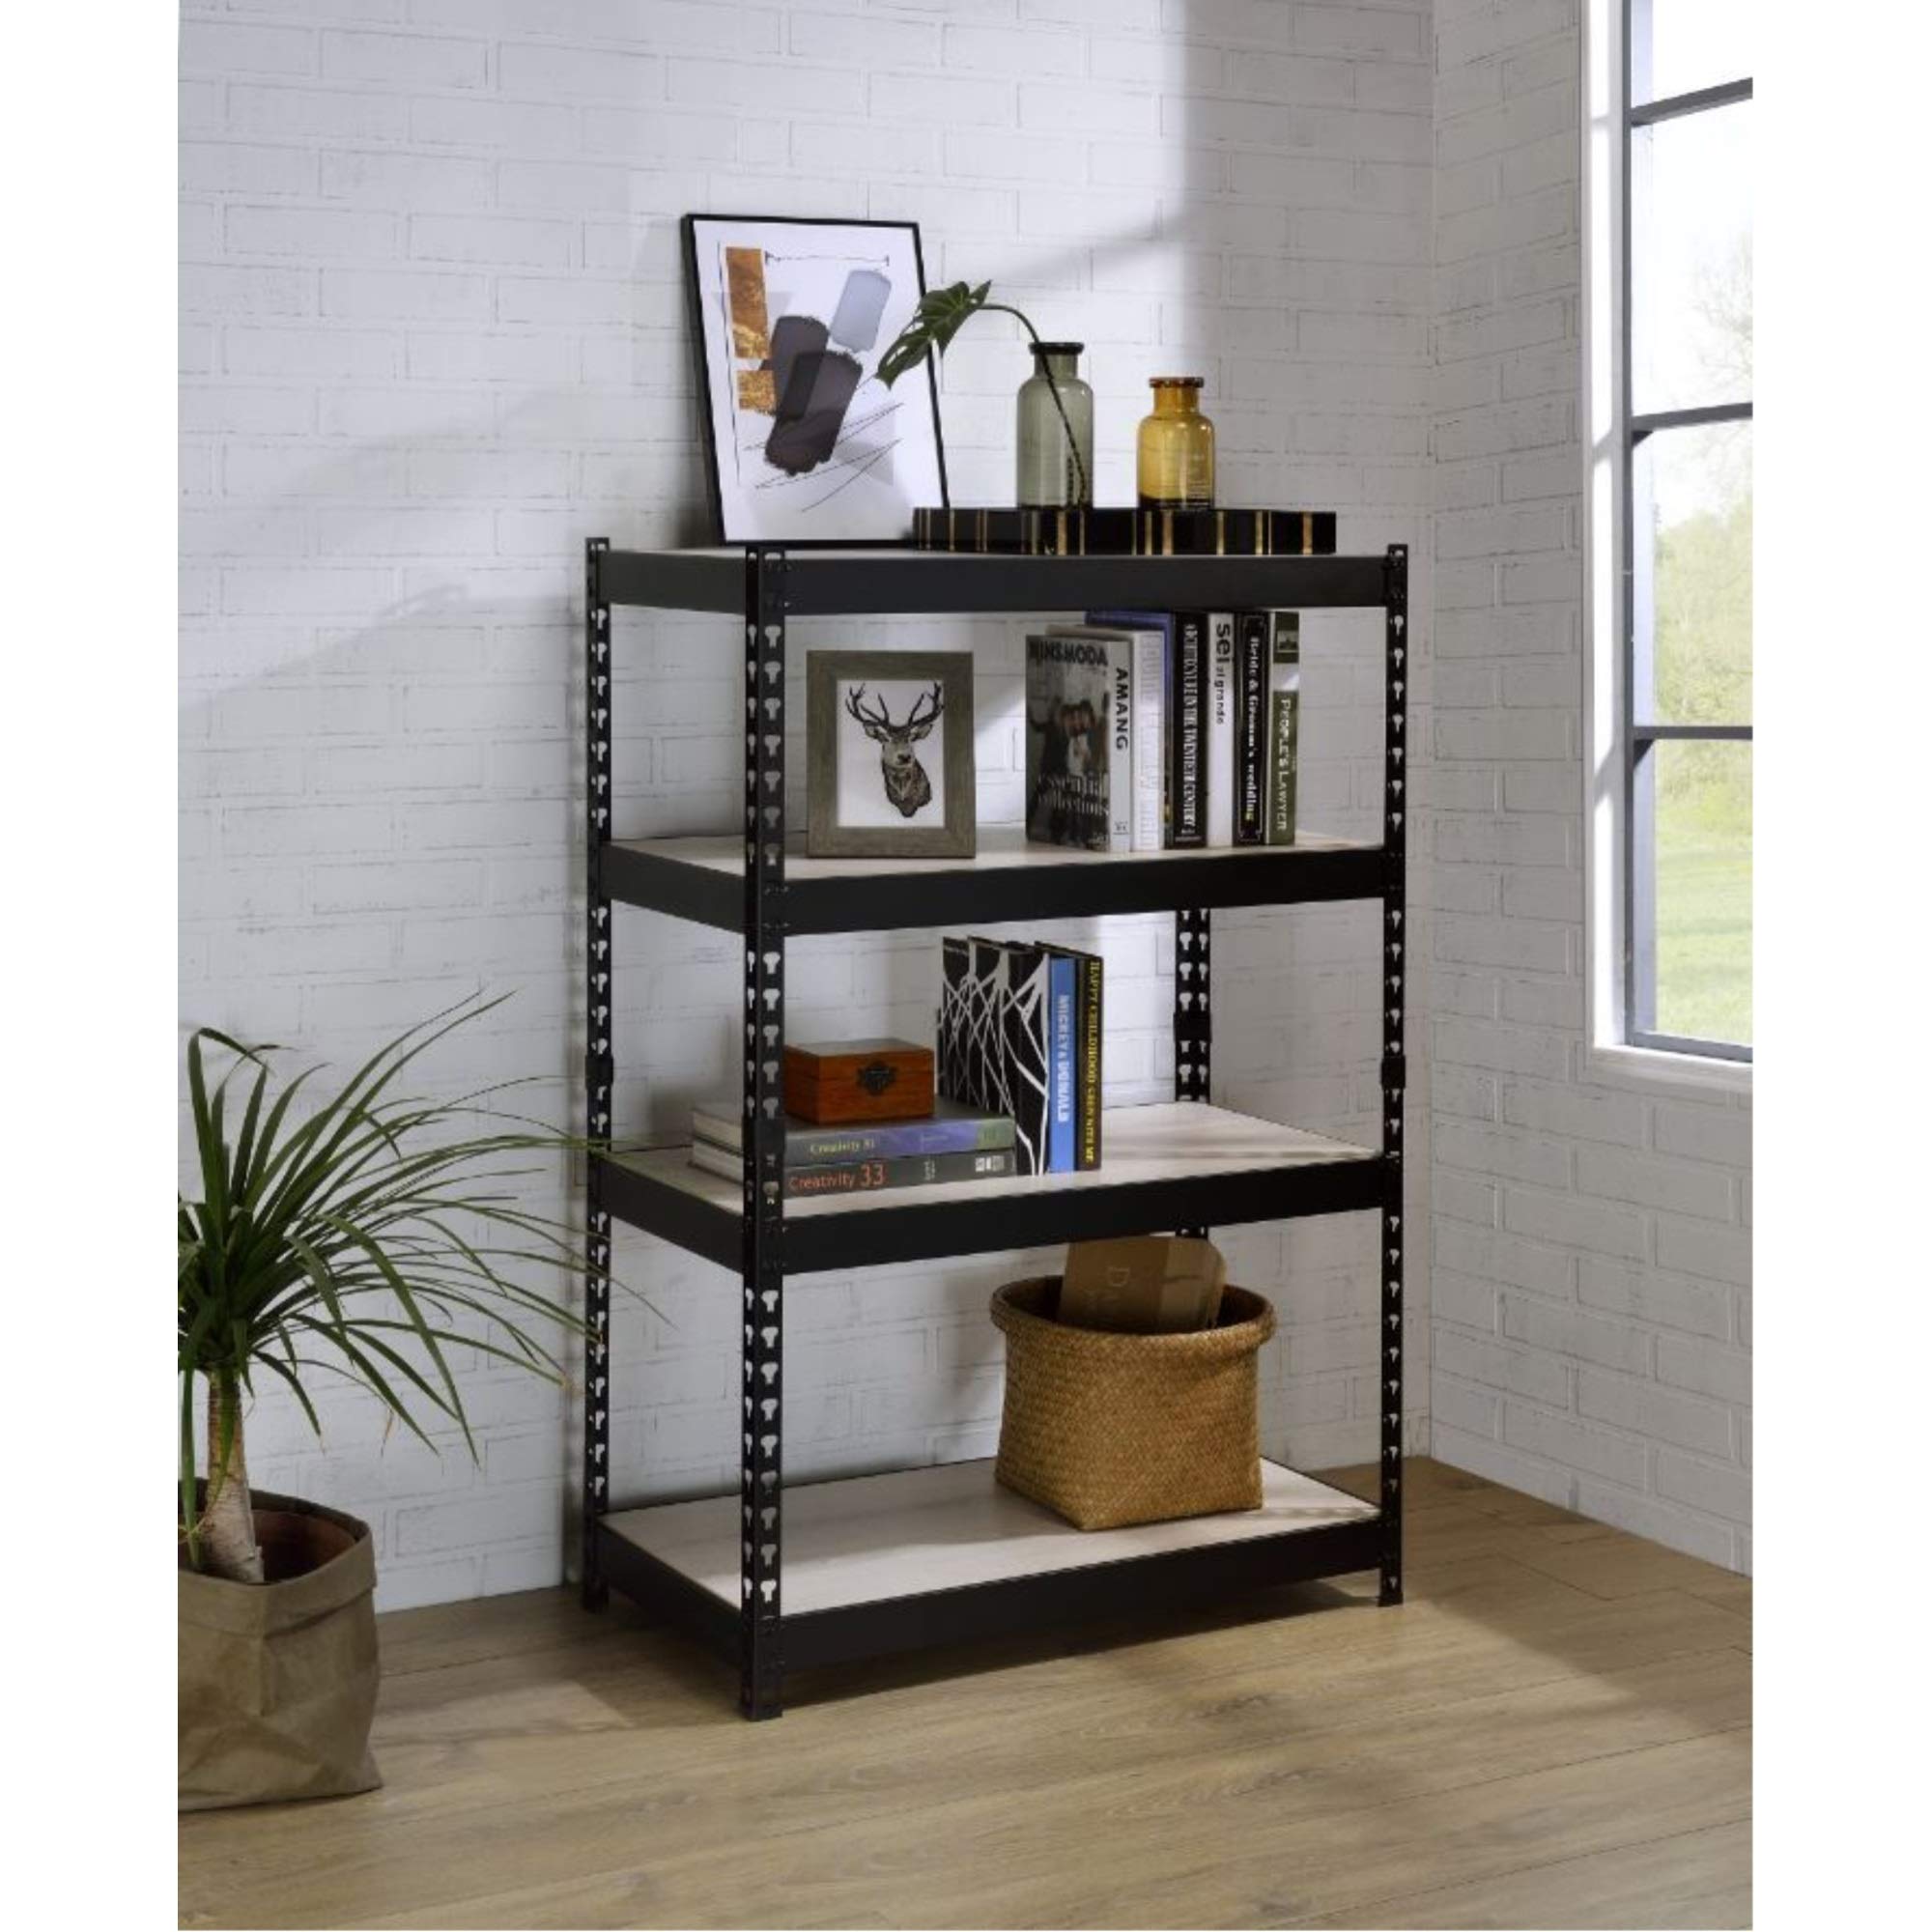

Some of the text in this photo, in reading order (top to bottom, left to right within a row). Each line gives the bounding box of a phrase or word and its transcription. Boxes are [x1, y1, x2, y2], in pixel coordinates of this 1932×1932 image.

[1116, 667, 1129, 751] AMANG
[1089, 960, 1100, 1003] HAPPY
[1057, 994, 1070, 1050] MICKEY
[1087, 1005, 1099, 1084] CHILDHOOD
[787, 1164, 887, 1192] Creativity 33
